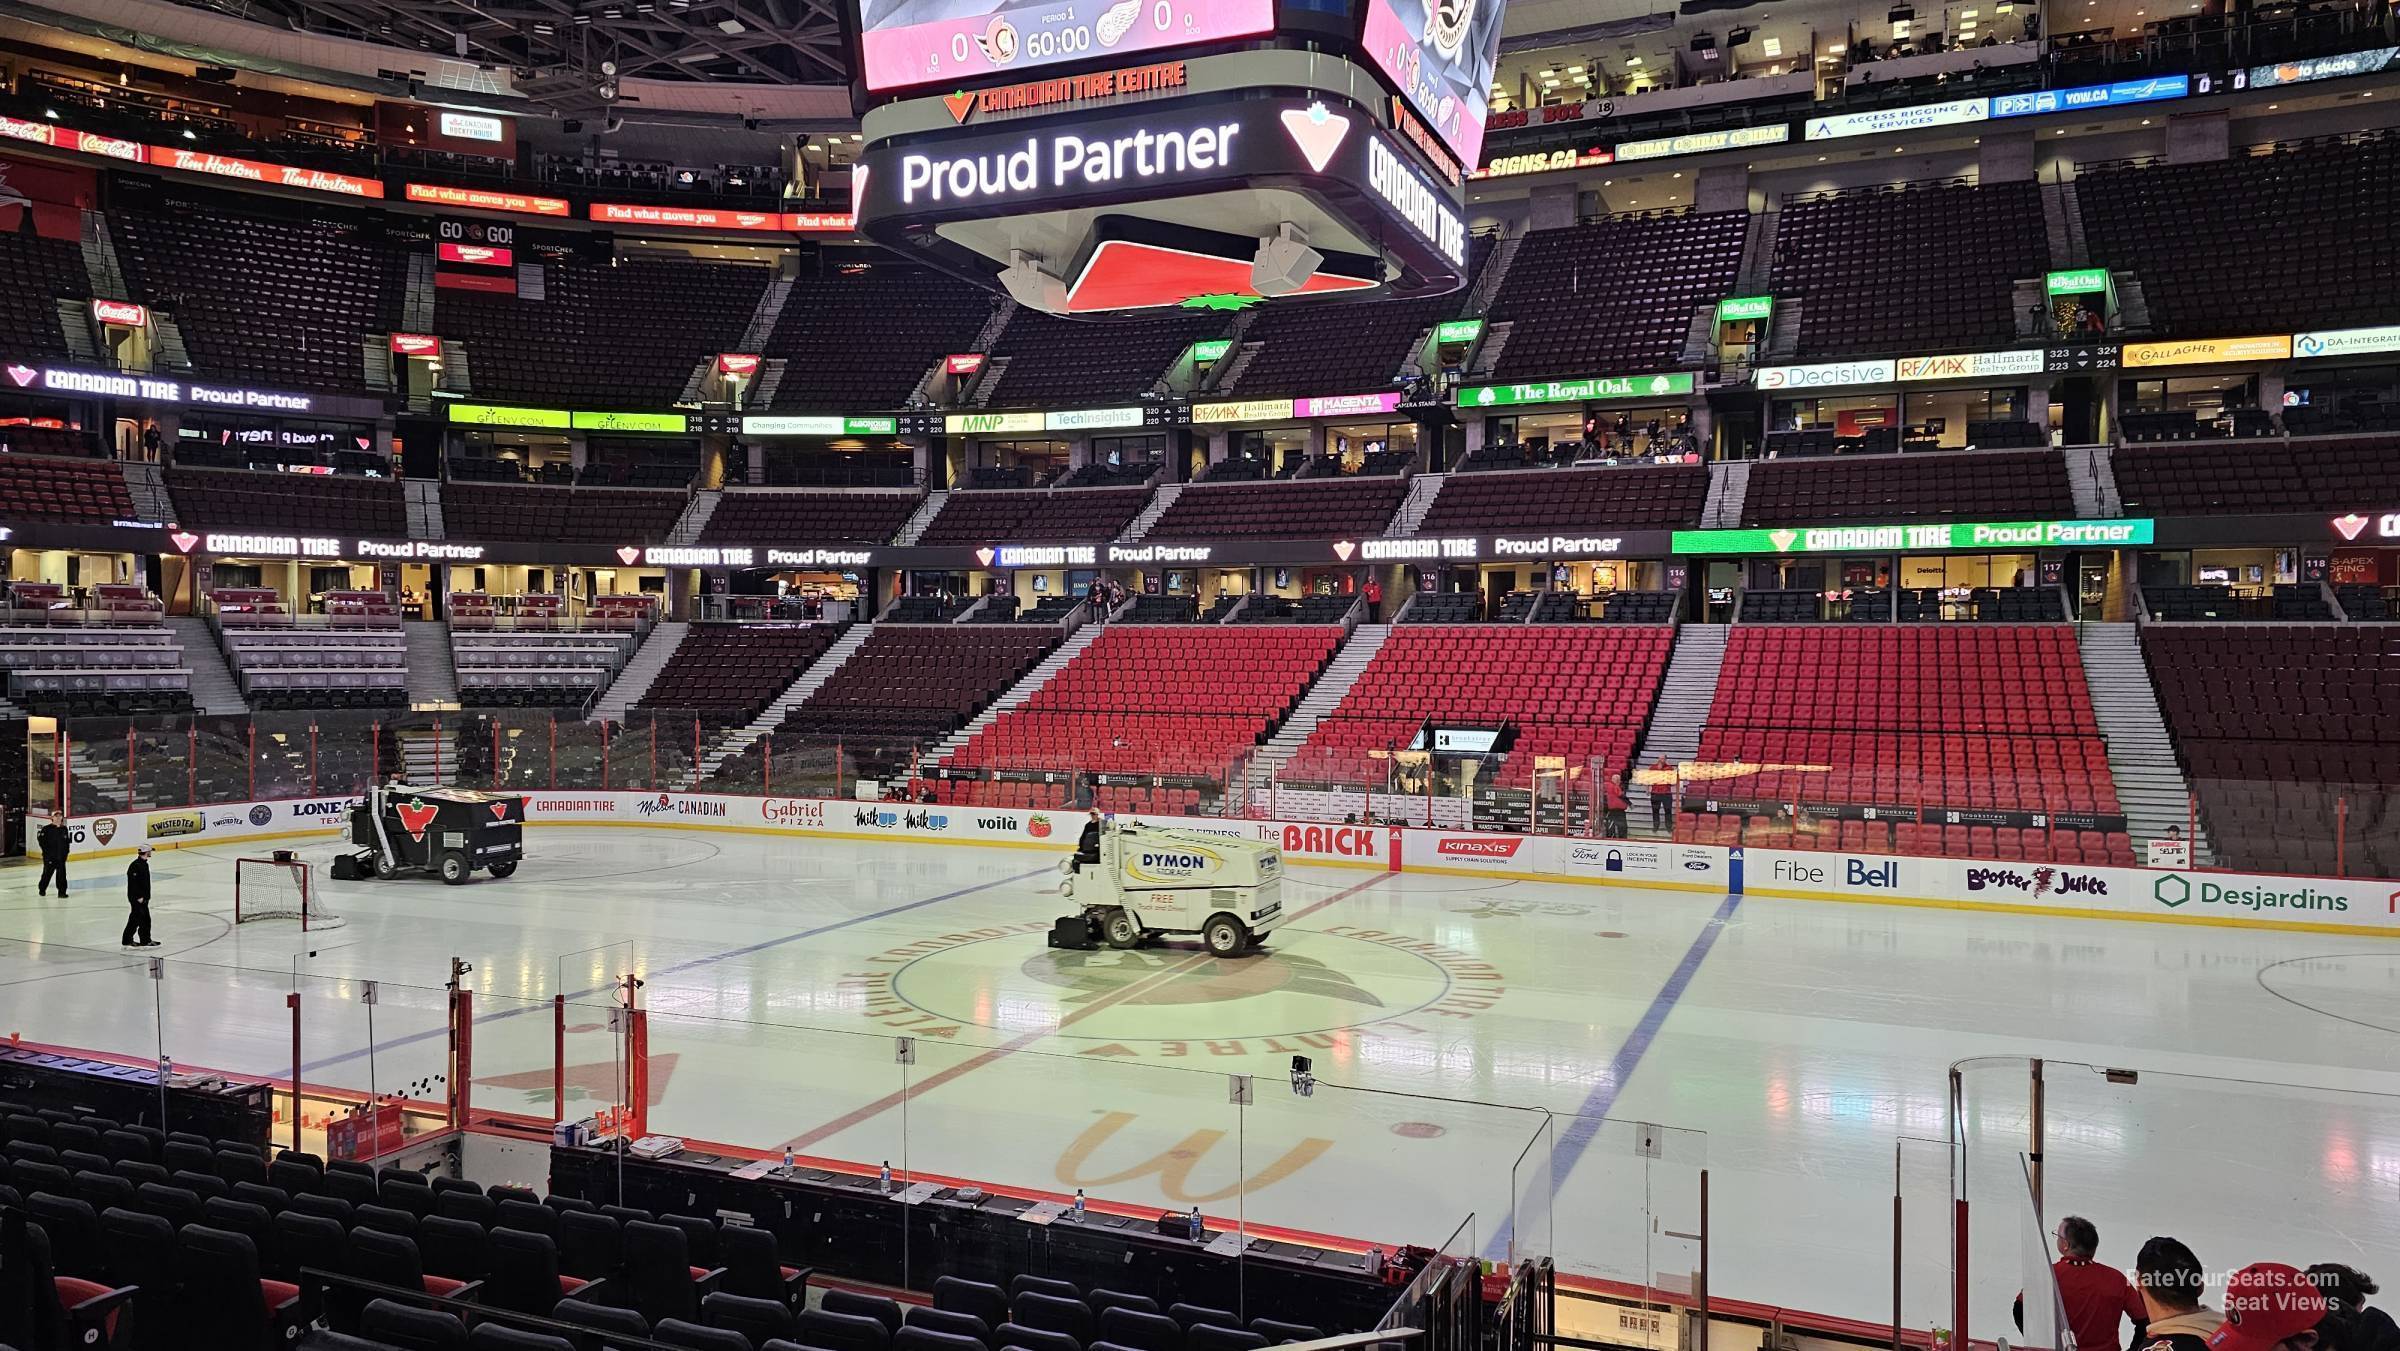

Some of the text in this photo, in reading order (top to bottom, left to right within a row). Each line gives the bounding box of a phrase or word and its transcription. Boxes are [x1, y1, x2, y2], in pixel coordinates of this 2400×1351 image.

[1067, 7, 1074, 20] 1
[1154, 2, 1171, 31] 0
[1185, 13, 1192, 27] 0
[952, 33, 968, 62] 0
[1026, 26, 1090, 59] 60:00
[930, 53, 938, 65] 0
[979, 62, 1187, 112] CANADIAN TIRE CENTRE
[2199, 77, 2210, 93] 0
[2233, 73, 2245, 90] 0
[1418, 82, 1438, 118] 60:00
[2066, 89, 2108, 105] YOW.CA
[1543, 103, 1584, 123] BOX
[1598, 102, 1612, 113] 18
[1848, 104, 1959, 124] ACCESS RIGGING
[1871, 116, 1933, 130] SERVICES
[1618, 134, 1728, 157] COMBAT COMBAT
[903, 122, 1240, 203] Proud Partner
[1489, 149, 1577, 176] SIGNS.CA
[175, 150, 364, 196] Tim Hortons Tim Hortons
[411, 186, 526, 209] Find what moves you
[1368, 136, 1465, 267] CANADIAN TIRE
[607, 207, 716, 225] Find what moves you
[440, 222, 513, 244] GO GO!
[532, 243, 574, 254] SPORTCHEK
[1973, 353, 2039, 365] Hallmark
[2049, 346, 2117, 358] 323 324
[2141, 344, 2216, 361] GALLAGHER
[1900, 357, 1967, 377] RE/MAX
[2002, 361, 2040, 373] Group
[2049, 359, 2116, 370] 223 224
[1789, 366, 1885, 386] Decisive
[45, 369, 310, 410] CANADIAN TIRE Proud Partner
[1512, 379, 1632, 400] The Royal Oak
[1244, 402, 1290, 411] Hallmark
[1323, 395, 1382, 409] MAGENTA
[1057, 410, 1132, 425] TechInsights
[1146, 407, 1159, 415] 320
[1194, 405, 1240, 421] RE/MAX
[752, 421, 786, 430] Changing
[962, 415, 1004, 431] MNP
[1805, 523, 2135, 549] CANADIAN TIRE Proud Partner
[207, 534, 485, 561] CANADIAN TIRE Proud Partner
[1000, 546, 1211, 565] CANADIAN TIRE Proud Partner
[1362, 535, 1622, 559] CANADIAN TIRE Proud Partner
[645, 547, 871, 566] CANADIAN TIRE Proud Partner
[2305, 560, 2326, 568] 118
[2043, 563, 2061, 571] 117
[293, 802, 341, 816] LONE
[536, 800, 615, 812] CANADIAN TIRE
[637, 798, 726, 817] Molson CANADIAN
[762, 798, 825, 820] Gabriel
[95, 823, 114, 831] HARD
[151, 818, 195, 832] TWISTED TEA
[780, 817, 825, 827] PIZZA
[977, 814, 1017, 831] voilà
[1257, 824, 1374, 857] The BRICK
[1143, 853, 1204, 869] DYMON
[1572, 848, 1600, 860] Ford
[1157, 867, 1193, 878] STORAGE
[1688, 861, 1707, 870] Ford
[1774, 859, 1898, 889] Fibe Bell
[1967, 868, 2108, 896] Booster Juice
[1151, 893, 1174, 904] FREE
[2201, 882, 2348, 912] Desjardins
